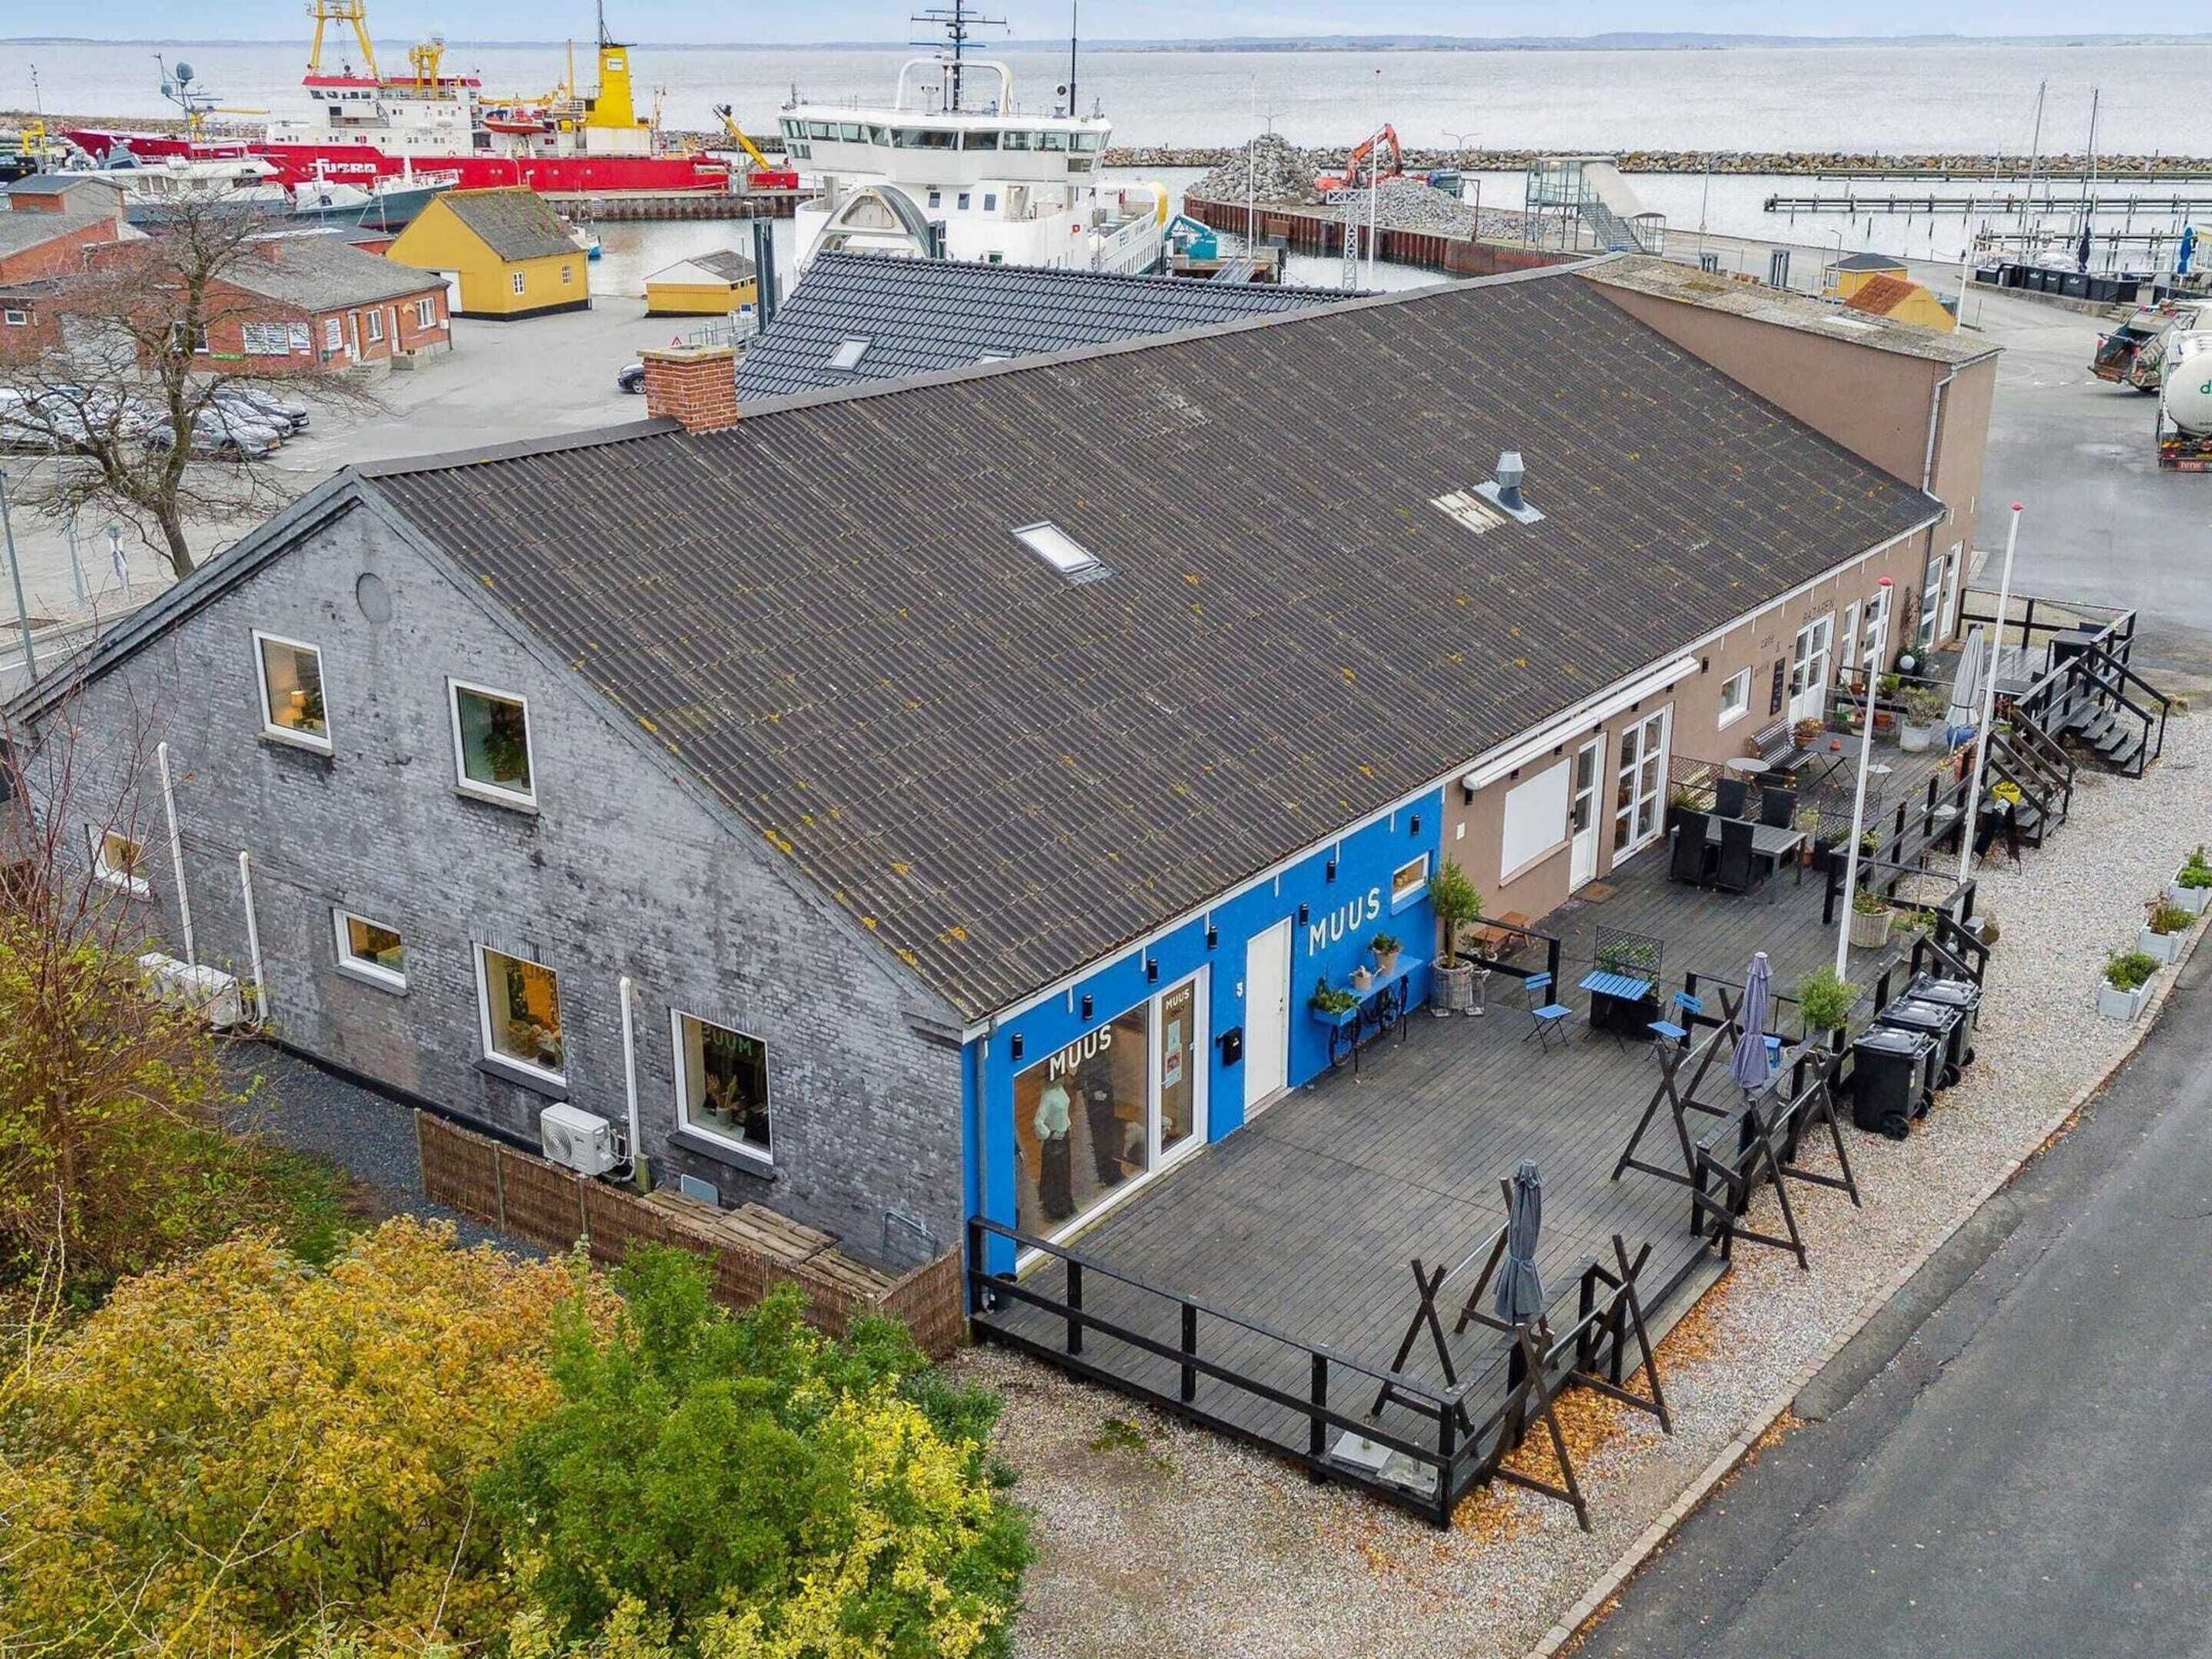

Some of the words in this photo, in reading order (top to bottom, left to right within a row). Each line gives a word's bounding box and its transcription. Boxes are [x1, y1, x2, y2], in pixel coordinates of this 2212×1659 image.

[1309, 887, 1381, 956] MUUS
[1166, 988, 1190, 1011] MUUS
[1050, 1024, 1112, 1081] MUUS
